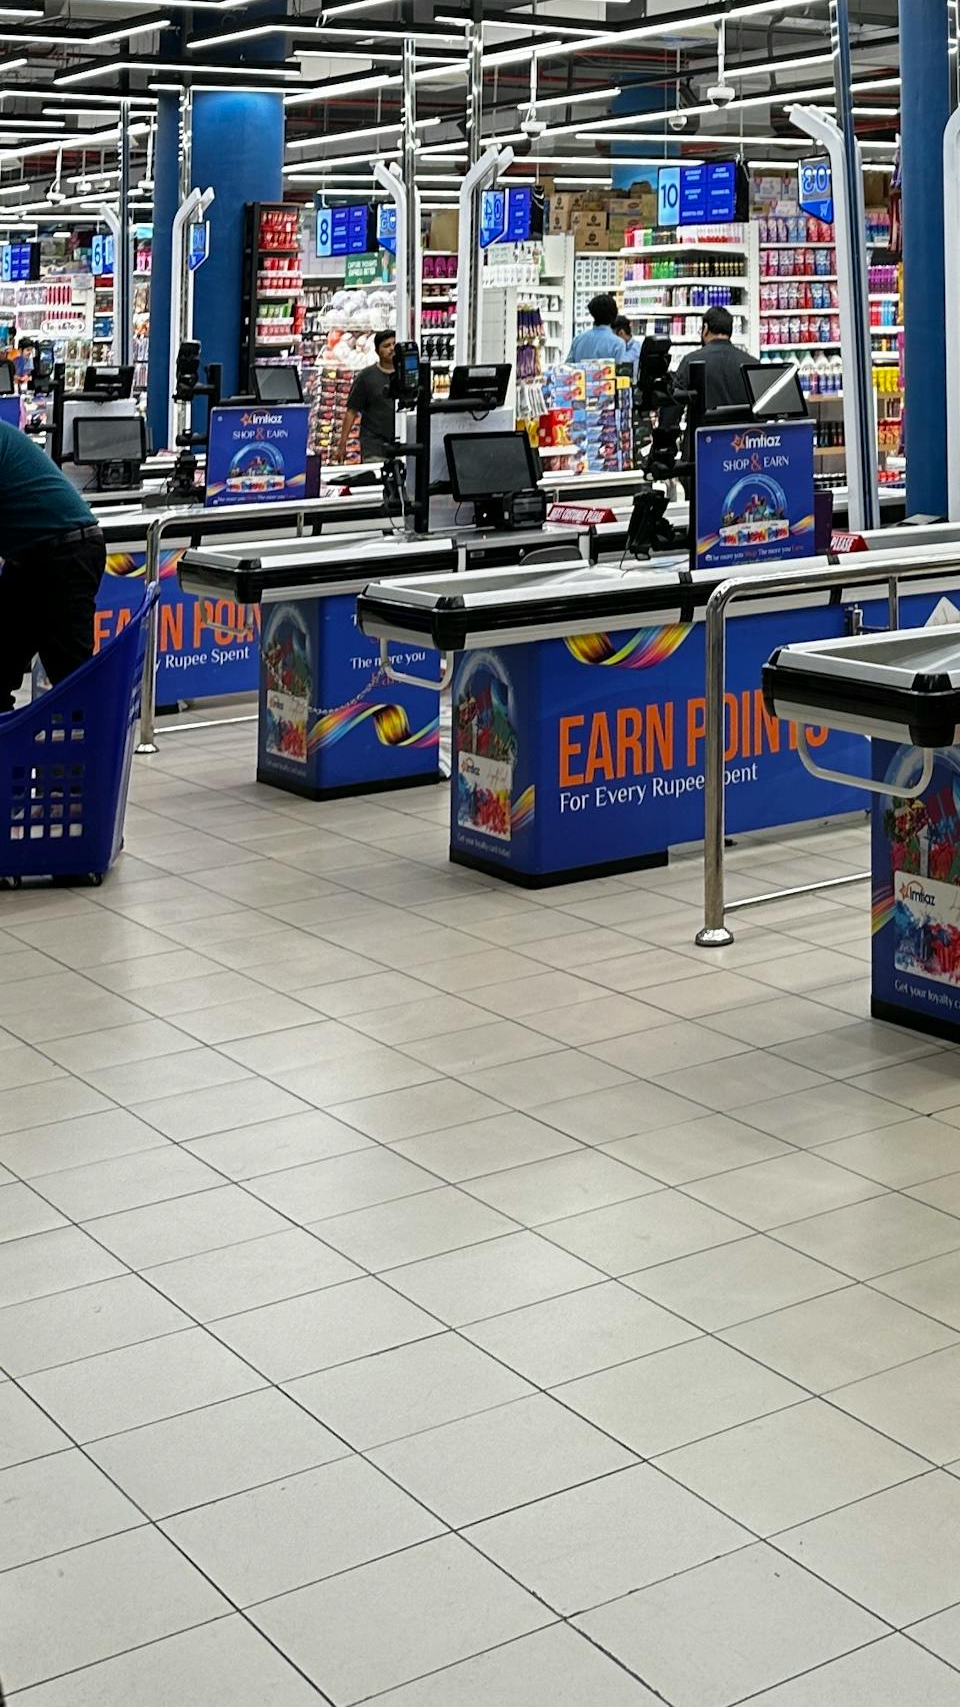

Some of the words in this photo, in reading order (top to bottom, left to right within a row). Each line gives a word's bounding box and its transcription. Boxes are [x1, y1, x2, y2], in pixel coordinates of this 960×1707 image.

[661, 183, 678, 208] 10
[320, 219, 329, 245] 8
[4, 252, 9, 273] 5
[95, 243, 100, 266] 6
[232, 431, 255, 440] SHOP
[255, 427, 264, 440] &
[745, 434, 782, 449] Imtiaz
[723, 458, 750, 472] SHOP
[750, 454, 762, 470] &
[764, 455, 790, 468] EARN
[831, 536, 855, 552] PLEASE
[165, 651, 208, 670] Rupee
[211, 646, 250, 666] Spent
[350, 656, 372, 670] The
[404, 650, 426, 666] you
[559, 701, 674, 788] EARN
[560, 792, 590, 813] For
[595, 784, 647, 807] Every
[652, 774, 706, 798] Rupee
[723, 763, 758, 786] pent
[910, 886, 936, 906] Imtiaz
[895, 979, 908, 994] Get
[910, 984, 926, 998] your
[928, 988, 952, 1008] loyalty
